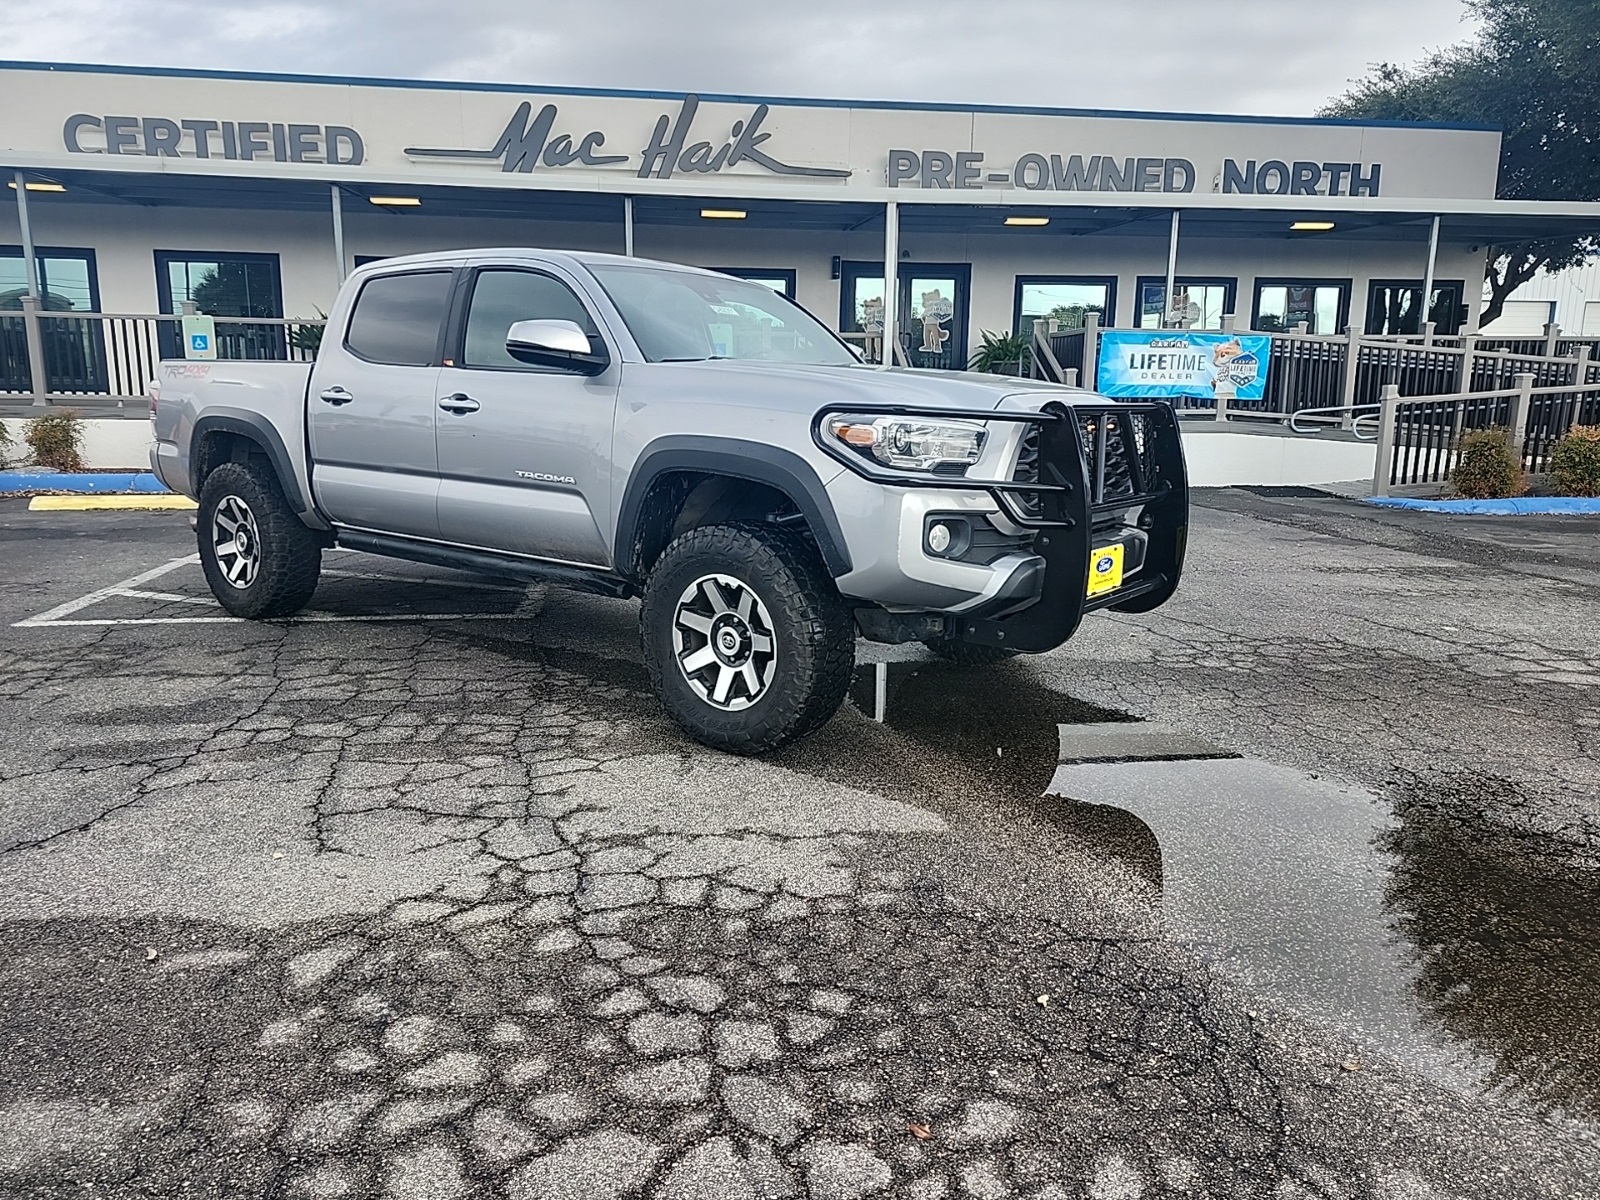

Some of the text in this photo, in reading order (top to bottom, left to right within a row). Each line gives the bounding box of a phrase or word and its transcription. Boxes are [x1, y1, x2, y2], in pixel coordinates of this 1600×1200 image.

[63, 113, 366, 166] CERTIFIED
[404, 93, 853, 179] Mac Haik
[888, 149, 1381, 197] PRE-OWNED NORTH
[1149, 340, 1189, 349] CARFAX
[1129, 353, 1207, 371] LIFETIME
[1141, 372, 1193, 380] DEALER
[514, 470, 576, 484] TACOMA
